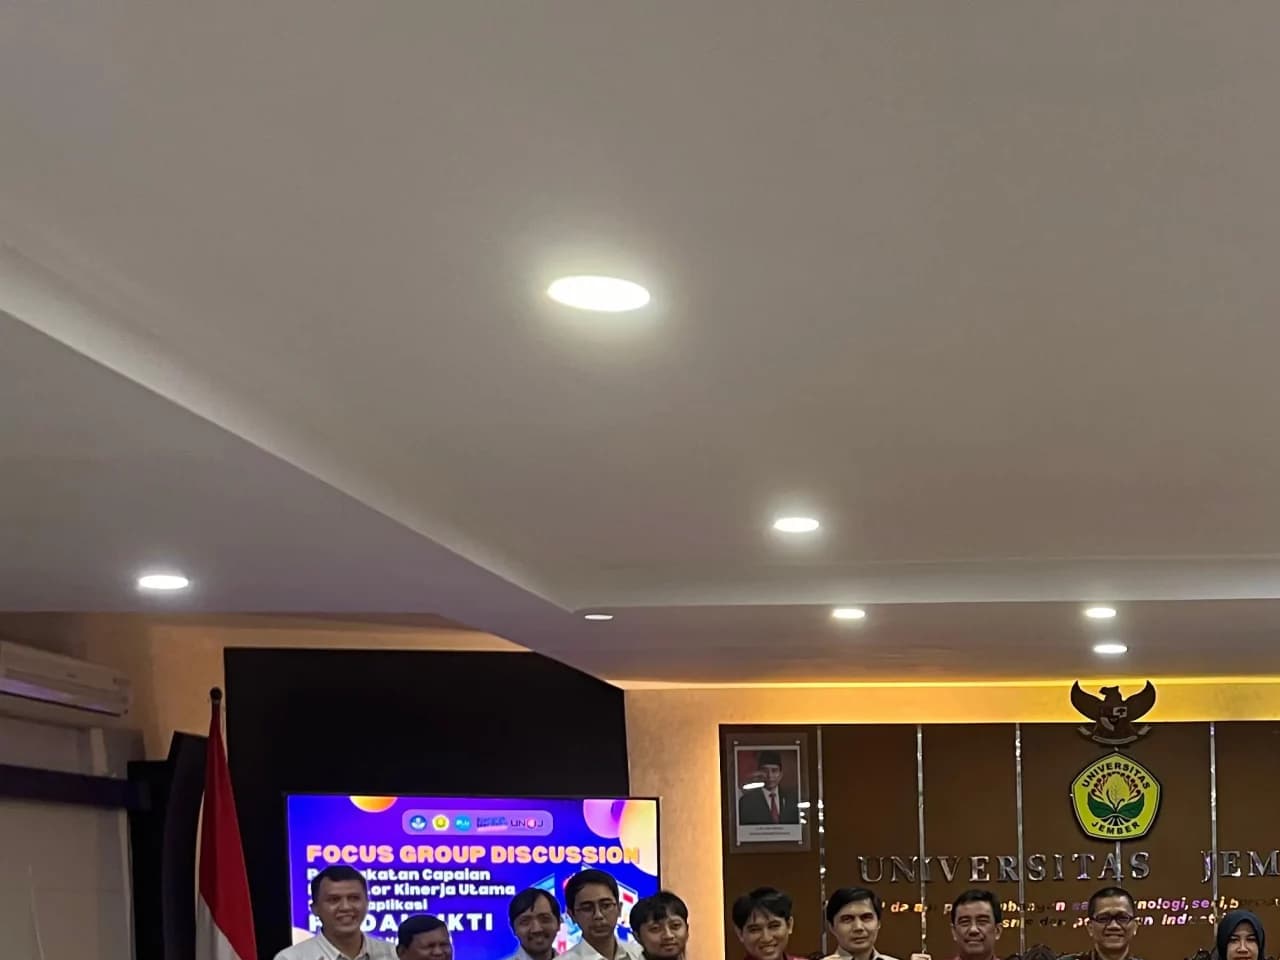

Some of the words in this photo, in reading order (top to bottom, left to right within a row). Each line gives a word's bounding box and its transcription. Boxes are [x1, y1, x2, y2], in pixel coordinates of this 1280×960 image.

[1082, 762, 1150, 788] UNIVERSITAS
[1091, 821, 1140, 835] JEMBER
[306, 845, 395, 863] FOCUS
[399, 845, 486, 864] GROUP
[491, 845, 640, 864] DISCUSSION
[422, 867, 490, 882] Capaian
[857, 851, 1150, 883] UNIVERSITAS
[394, 884, 456, 898] Kinerja
[459, 883, 516, 896] Utama
[368, 899, 428, 912] aplikasi
